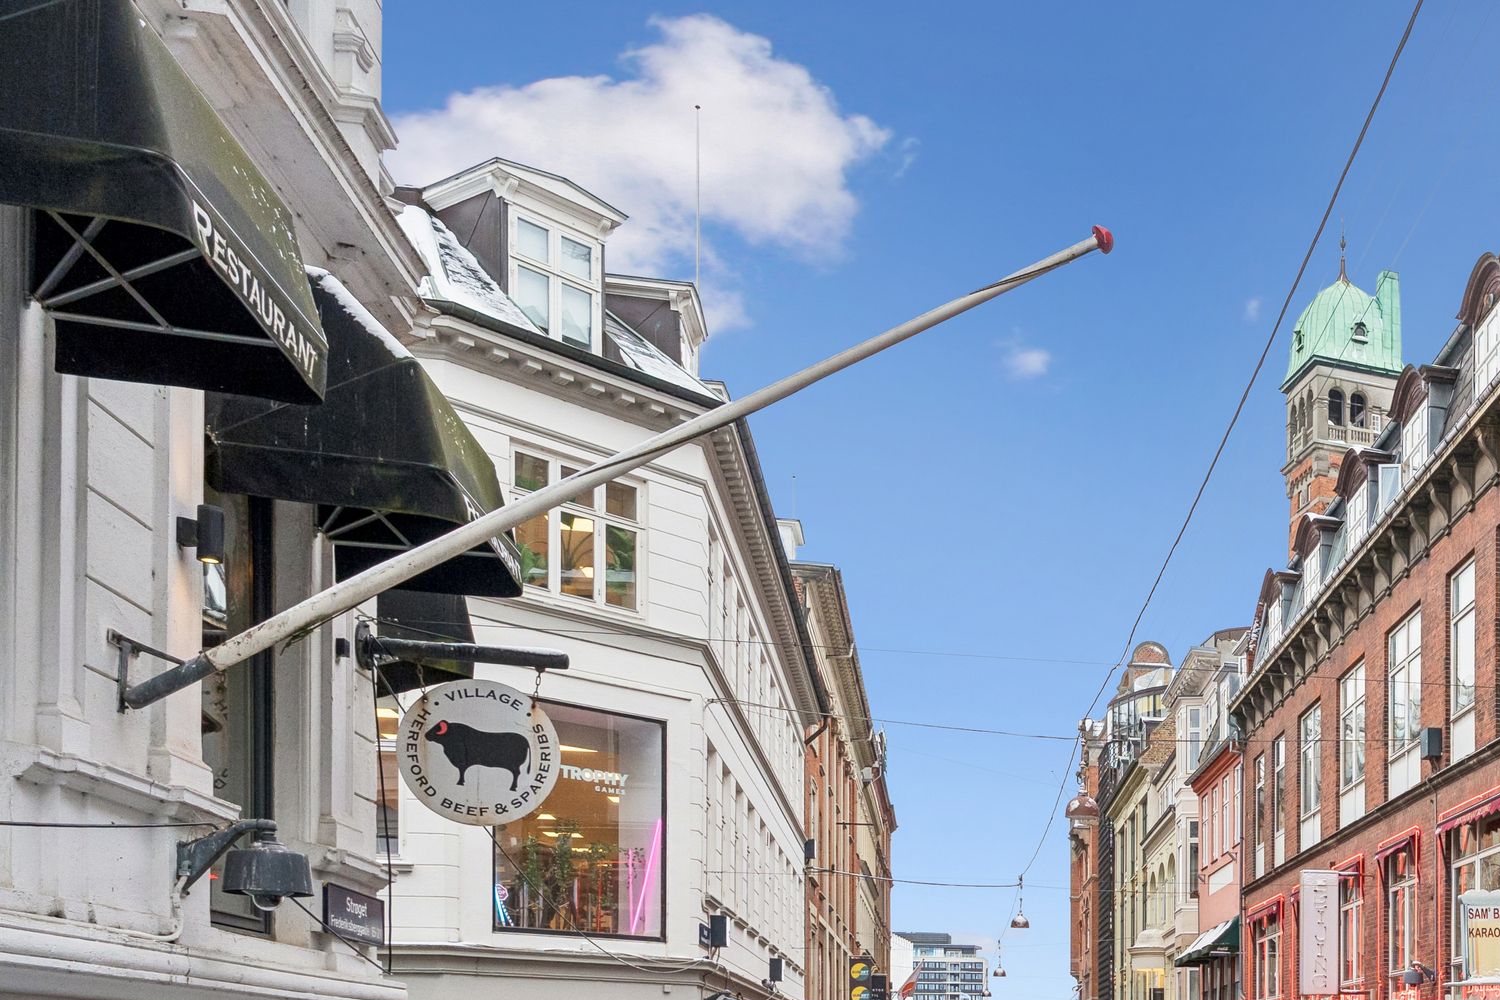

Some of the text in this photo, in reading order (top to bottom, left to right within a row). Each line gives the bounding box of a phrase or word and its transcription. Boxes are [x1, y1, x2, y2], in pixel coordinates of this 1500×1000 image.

[191, 199, 319, 380] RESTAURANT
[445, 688, 523, 711] VILLAGE
[406, 708, 551, 816] HEREFORD BEEF & SPARERIBS
[560, 764, 630, 788] TROPHY
[594, 785, 626, 795] GAMES
[346, 896, 368, 918] Strøget
